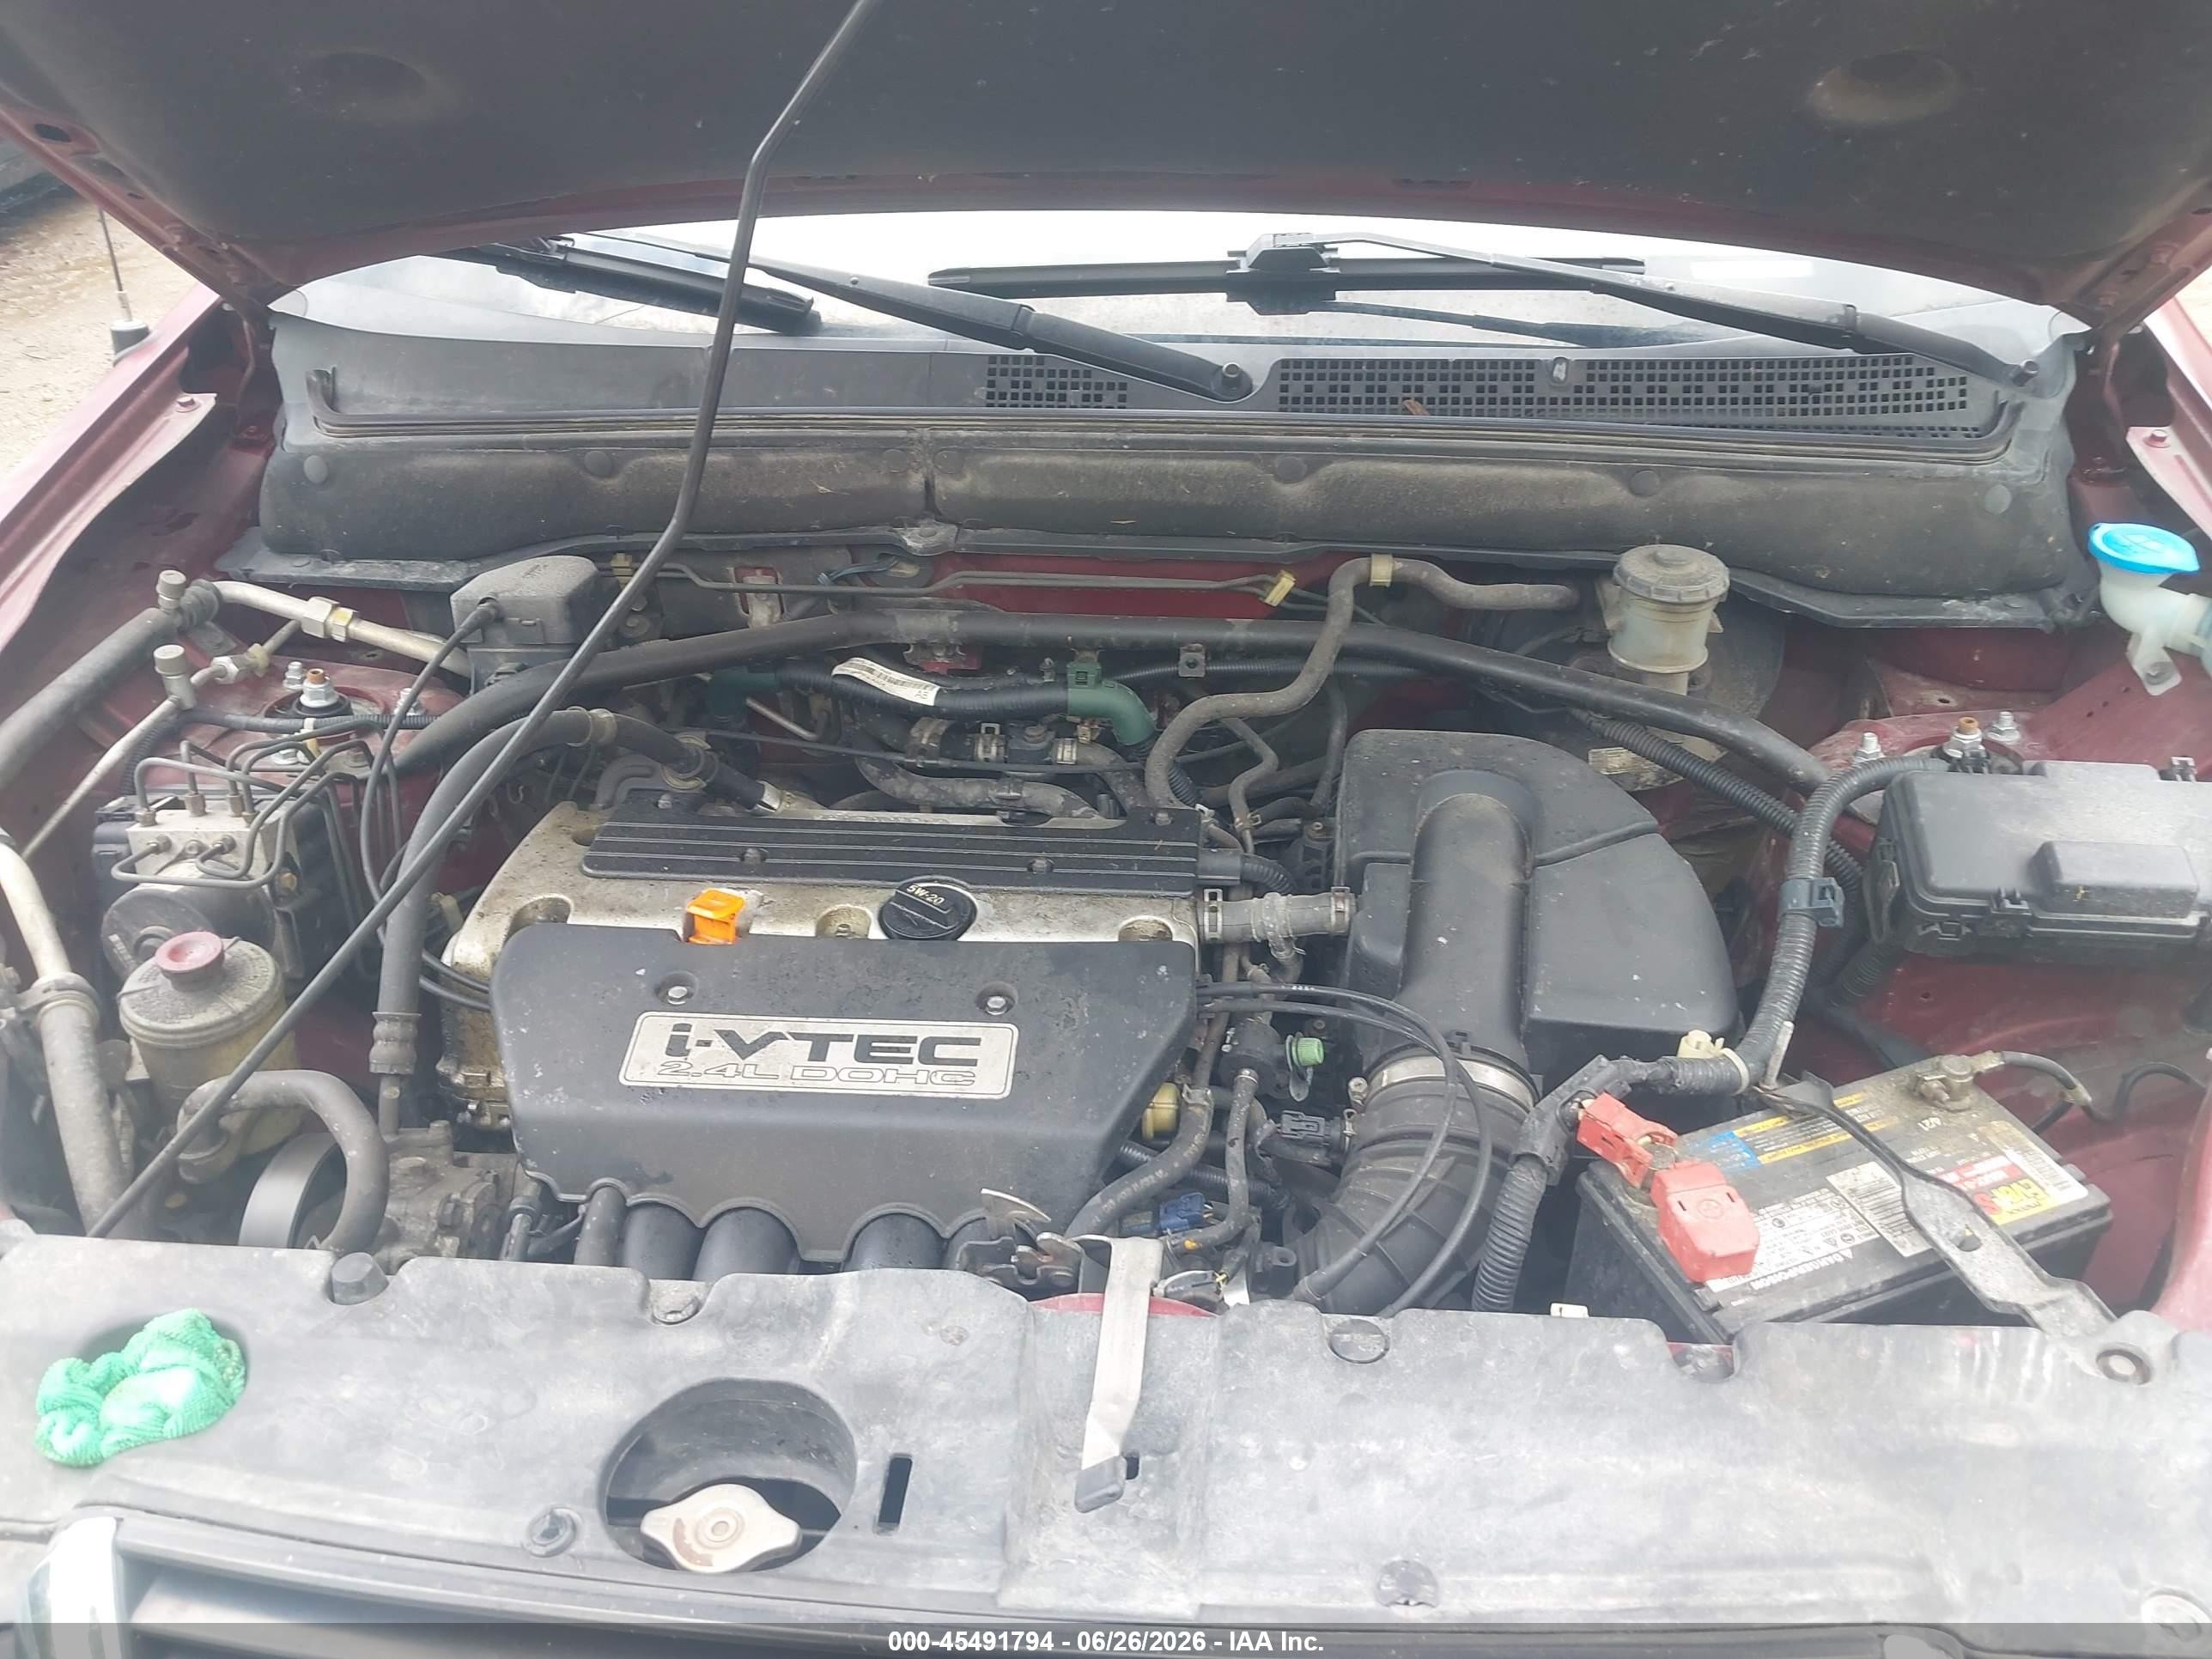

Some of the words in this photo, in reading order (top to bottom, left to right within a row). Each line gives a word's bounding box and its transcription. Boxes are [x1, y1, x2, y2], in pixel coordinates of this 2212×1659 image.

[906, 884, 945, 906] 5W-20
[665, 1022, 981, 1066] i-VTEC
[659, 1060, 780, 1079] 2.4L
[790, 1065, 976, 1086] DOHC
